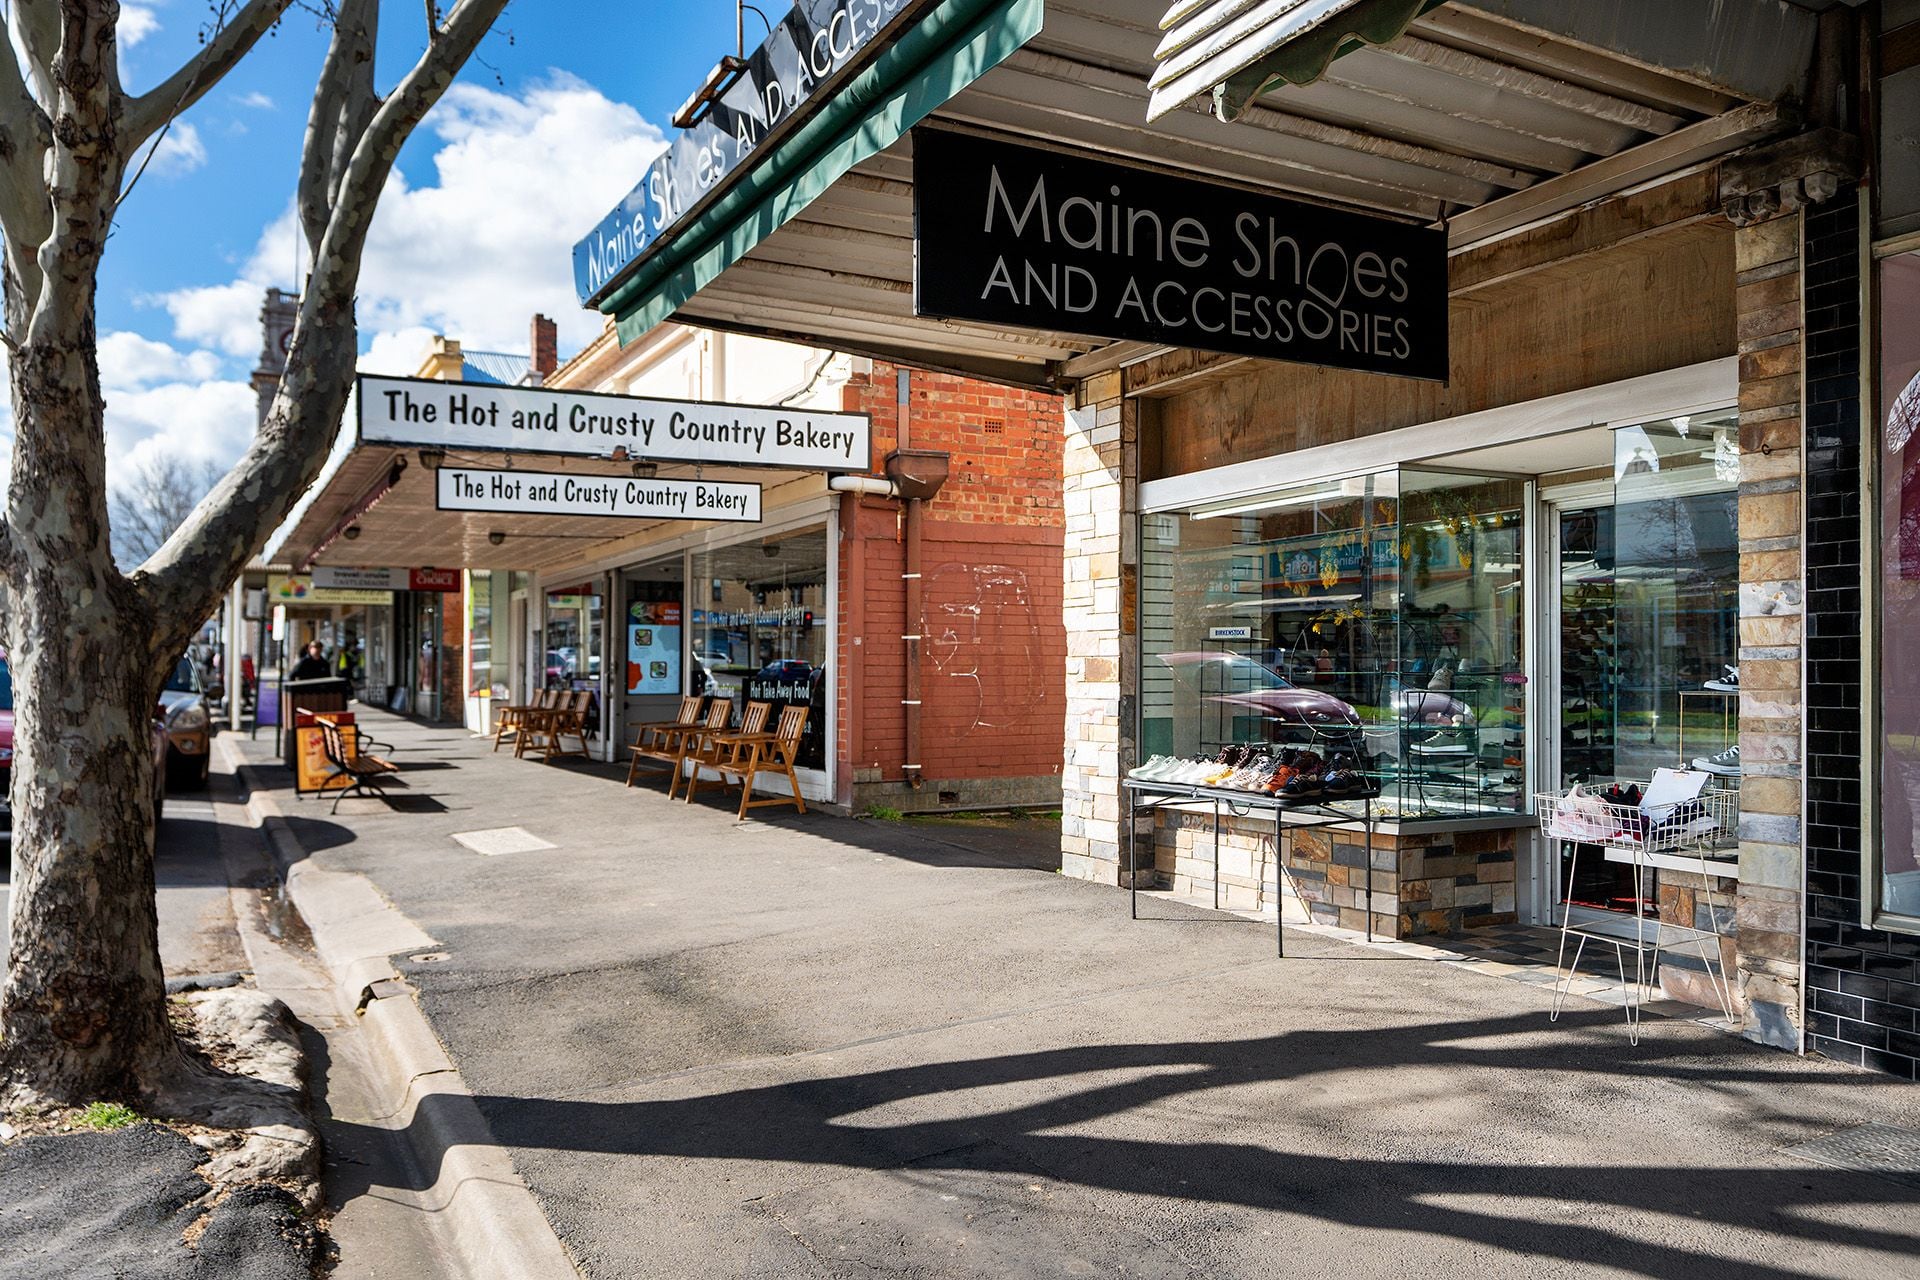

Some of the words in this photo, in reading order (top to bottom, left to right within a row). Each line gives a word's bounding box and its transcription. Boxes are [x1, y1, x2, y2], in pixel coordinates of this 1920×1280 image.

[736, 80, 783, 158] AND
[588, 212, 646, 293] Maine
[984, 163, 1210, 268] Maine
[1232, 211, 1409, 308] Shoes
[981, 254, 1098, 313] AND
[1114, 276, 1411, 360] ACCESSORIES
[383, 390, 437, 423] The
[449, 393, 499, 428] Hot
[511, 402, 558, 432] and
[569, 404, 655, 446] Crusty
[669, 411, 766, 454] Country
[776, 419, 855, 458] Bakery
[452, 473, 485, 498] The
[491, 474, 521, 500] Hot
[528, 477, 557, 502] and
[564, 479, 618, 511] Crusty
[625, 481, 688, 513] Country
[696, 486, 748, 516] Bakery
[758, 605, 781, 627] Country
[782, 602, 804, 625] Bakery
[750, 681, 761, 698] Hot
[762, 681, 776, 699] Take
[776, 680, 793, 704] Away
[794, 680, 810, 699] Food
